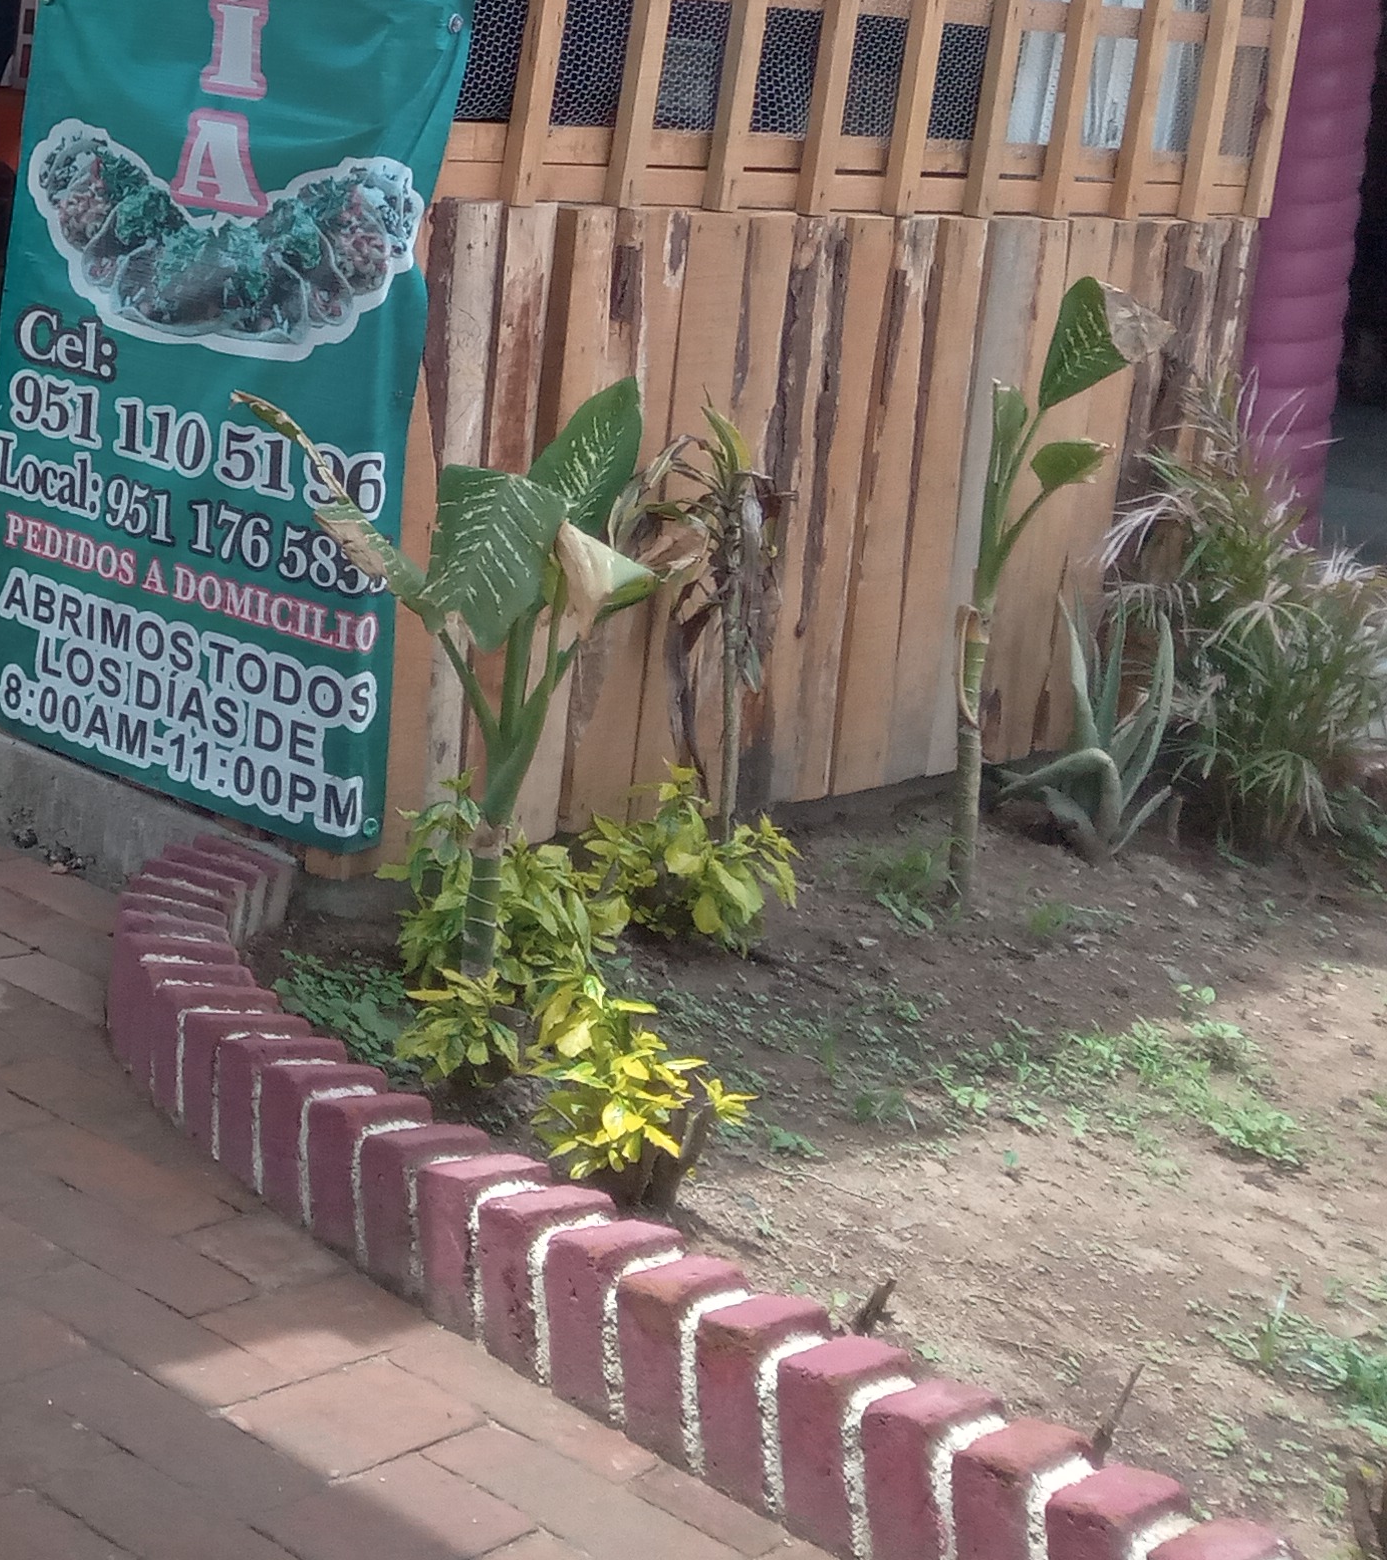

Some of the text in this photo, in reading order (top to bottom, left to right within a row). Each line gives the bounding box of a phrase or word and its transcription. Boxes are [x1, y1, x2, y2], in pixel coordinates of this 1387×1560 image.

[18, 307, 116, 379] Cel:
[12, 372, 384, 519] 951 110 51 96
[5, 513, 378, 652] PEDIDOS A DOMICILIO
[106, 477, 172, 545] 951
[192, 500, 269, 569] 176
[2, 576, 373, 725] ABRIMOS TODOS
[41, 638, 319, 767] LOS DÍAS DE
